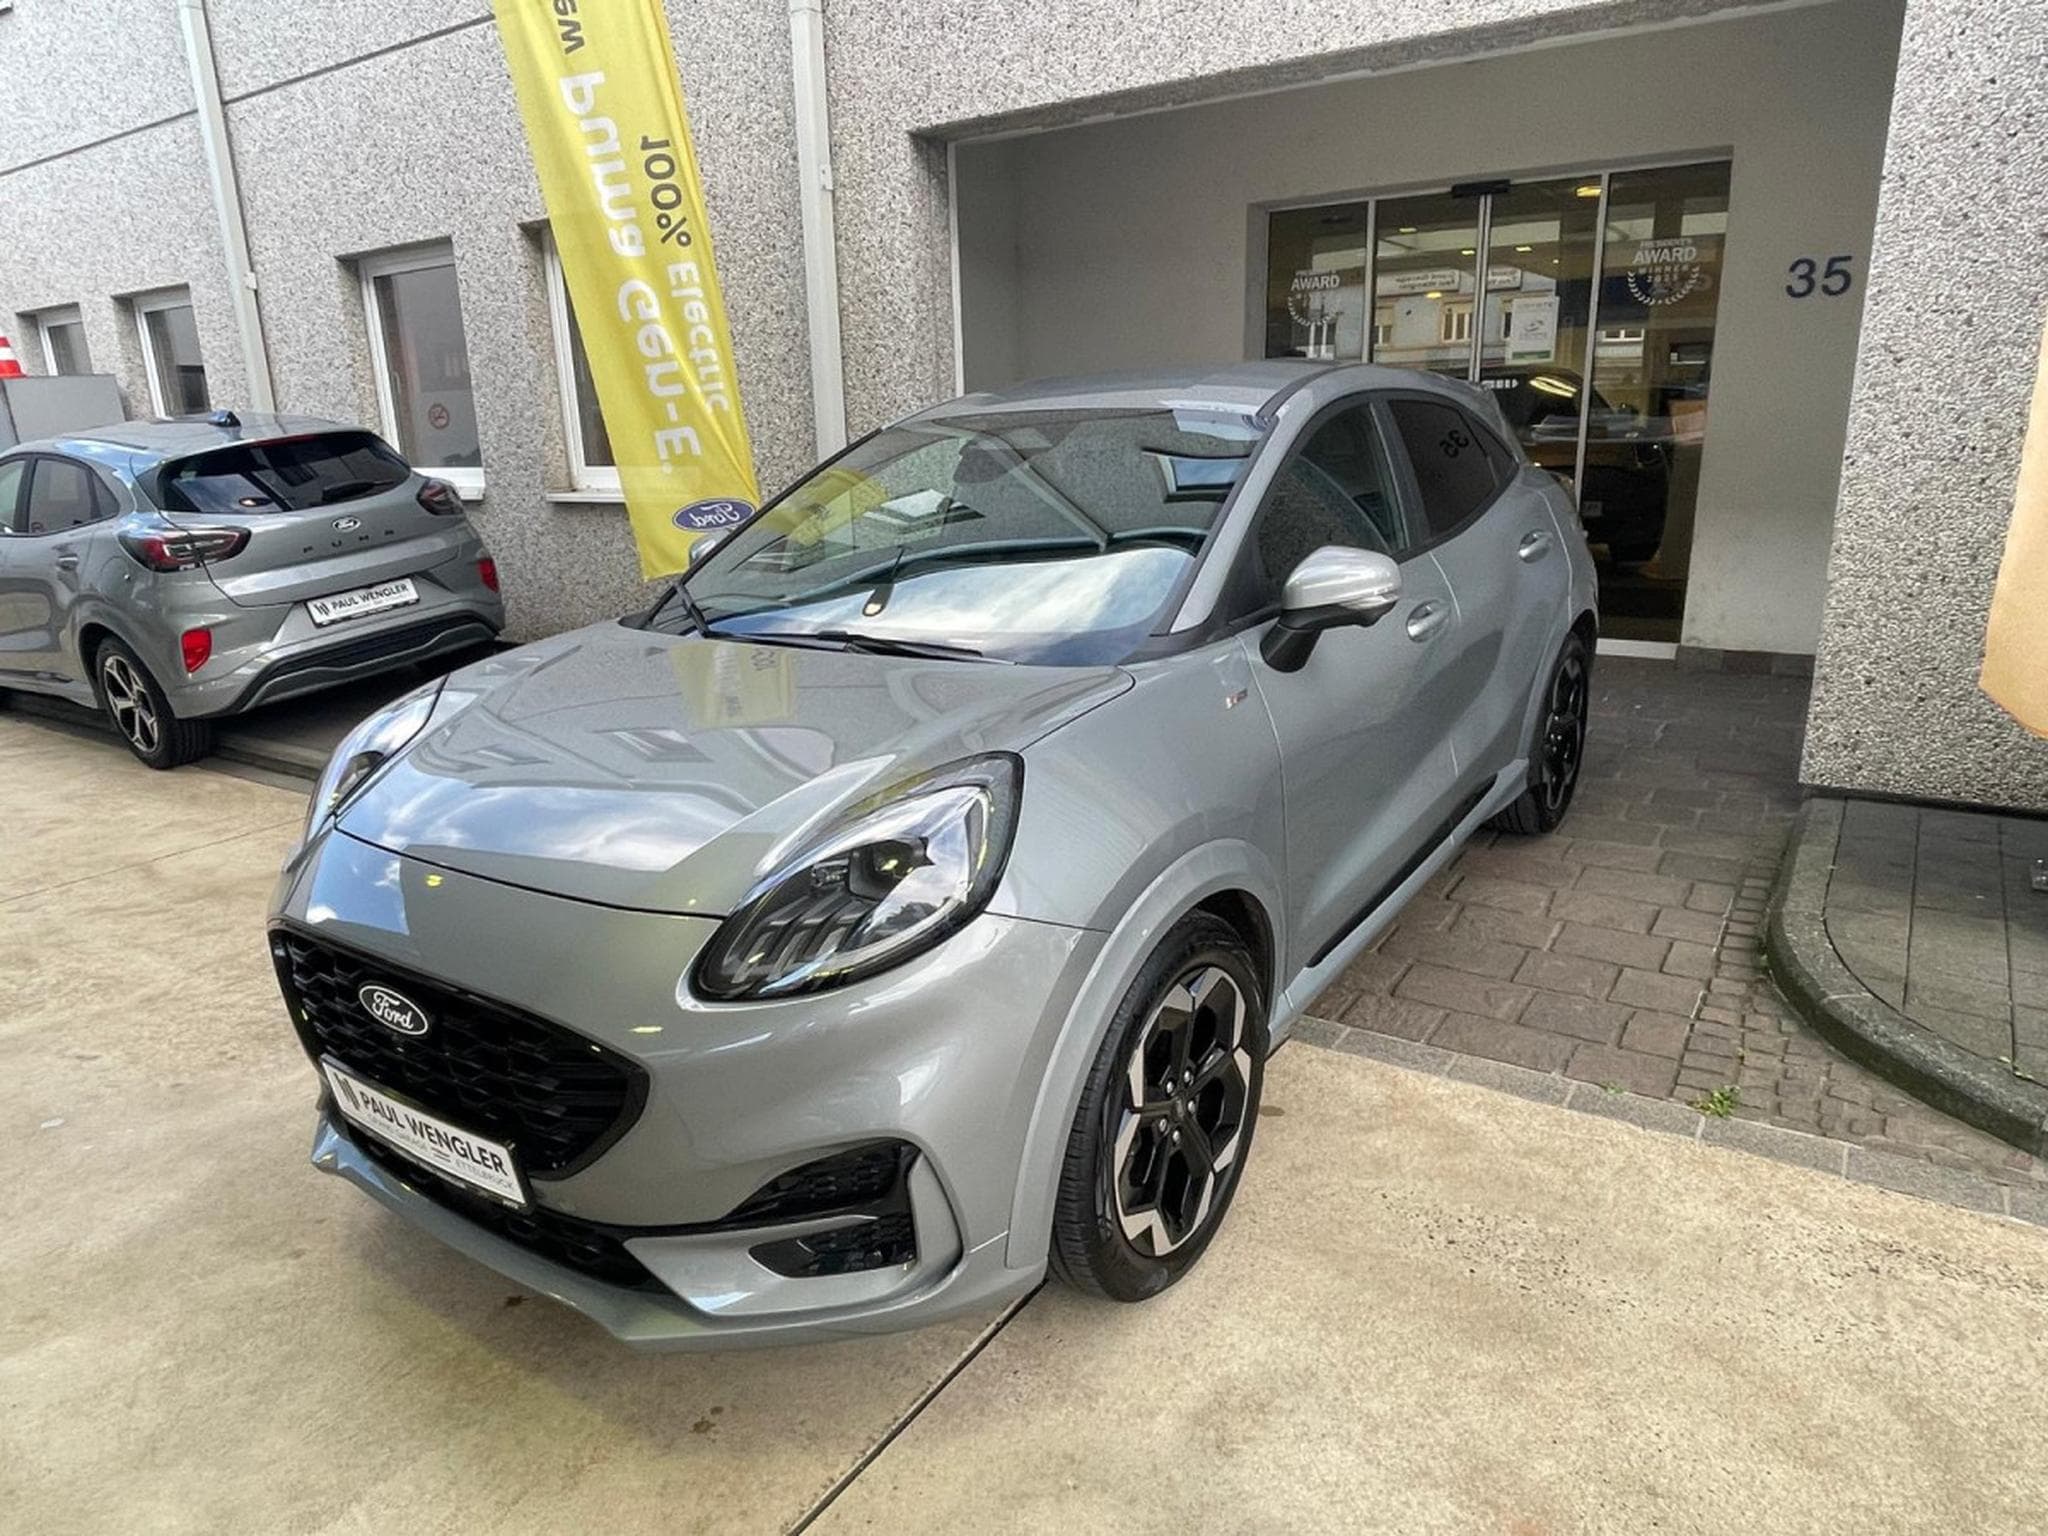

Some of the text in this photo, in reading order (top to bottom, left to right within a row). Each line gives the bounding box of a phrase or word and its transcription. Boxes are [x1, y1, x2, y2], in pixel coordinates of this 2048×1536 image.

[1632, 246, 1697, 264] AWARD
[1290, 274, 1340, 291] AWARD
[1786, 255, 1853, 298] 35
[331, 583, 409, 611] PAUL WENGLER
[360, 1091, 508, 1176] PAUL WENGLER
